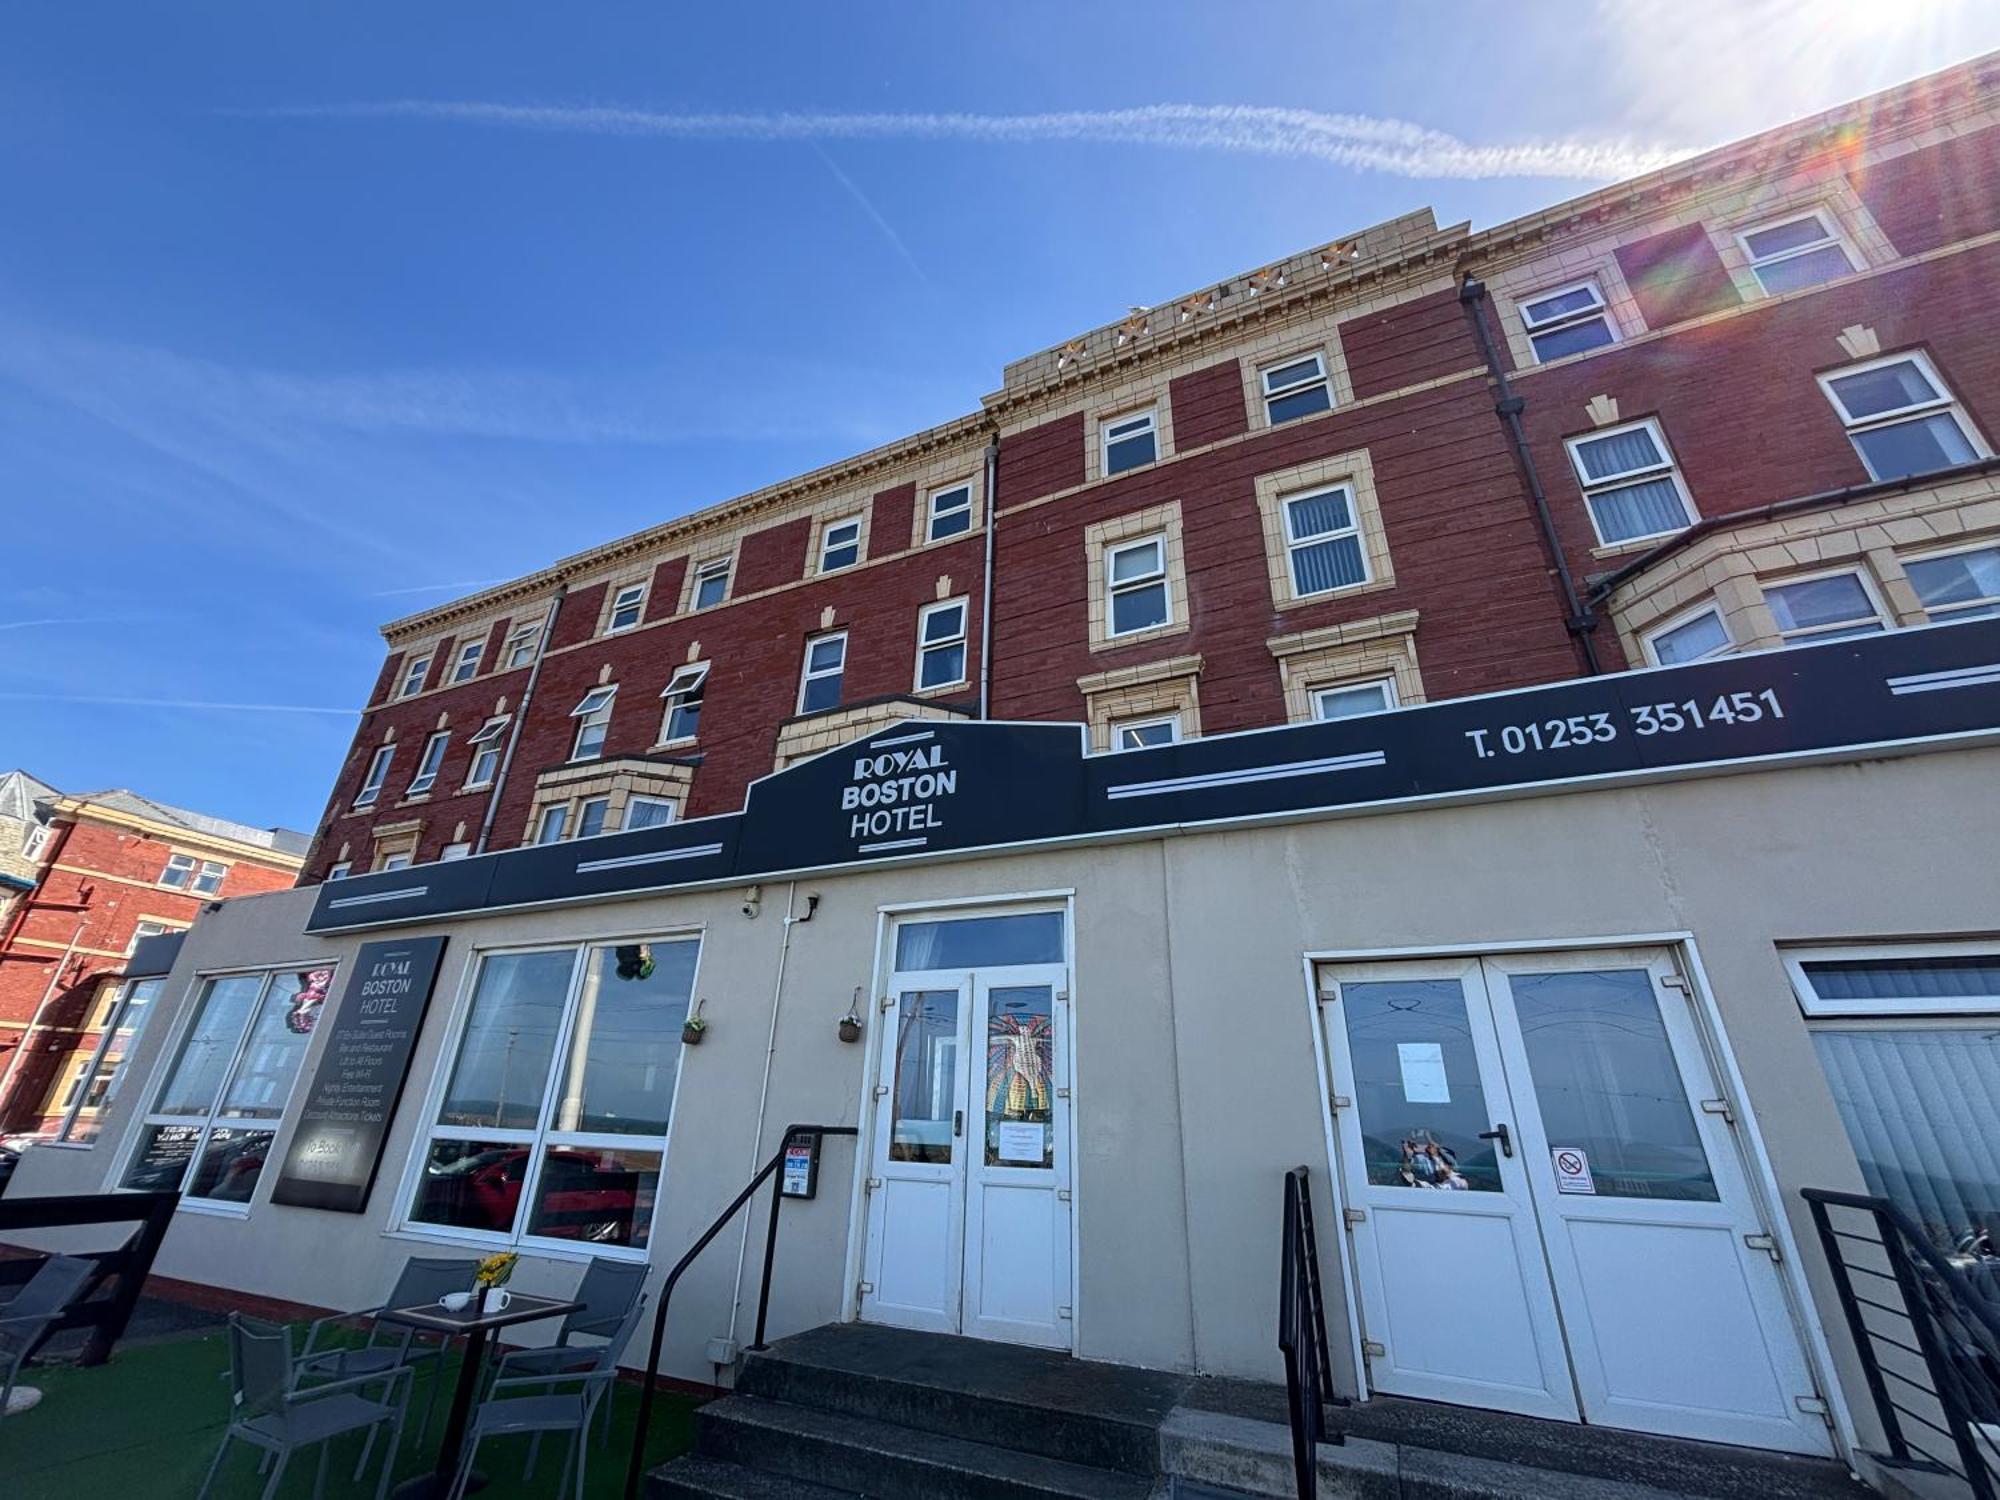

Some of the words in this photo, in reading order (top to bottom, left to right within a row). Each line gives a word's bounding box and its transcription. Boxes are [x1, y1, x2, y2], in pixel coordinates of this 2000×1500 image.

[1465, 728, 1496, 758] T.
[1501, 711, 1618, 755] 01253
[1629, 687, 1786, 737] 351451
[853, 744, 949, 781] ROYAL
[841, 770, 957, 811] BOSTON
[850, 803, 943, 839] HOTEL
[361, 977, 412, 995] BOSTON
[371, 961, 412, 977] ROYAL
[360, 998, 399, 1014] HOTEL
